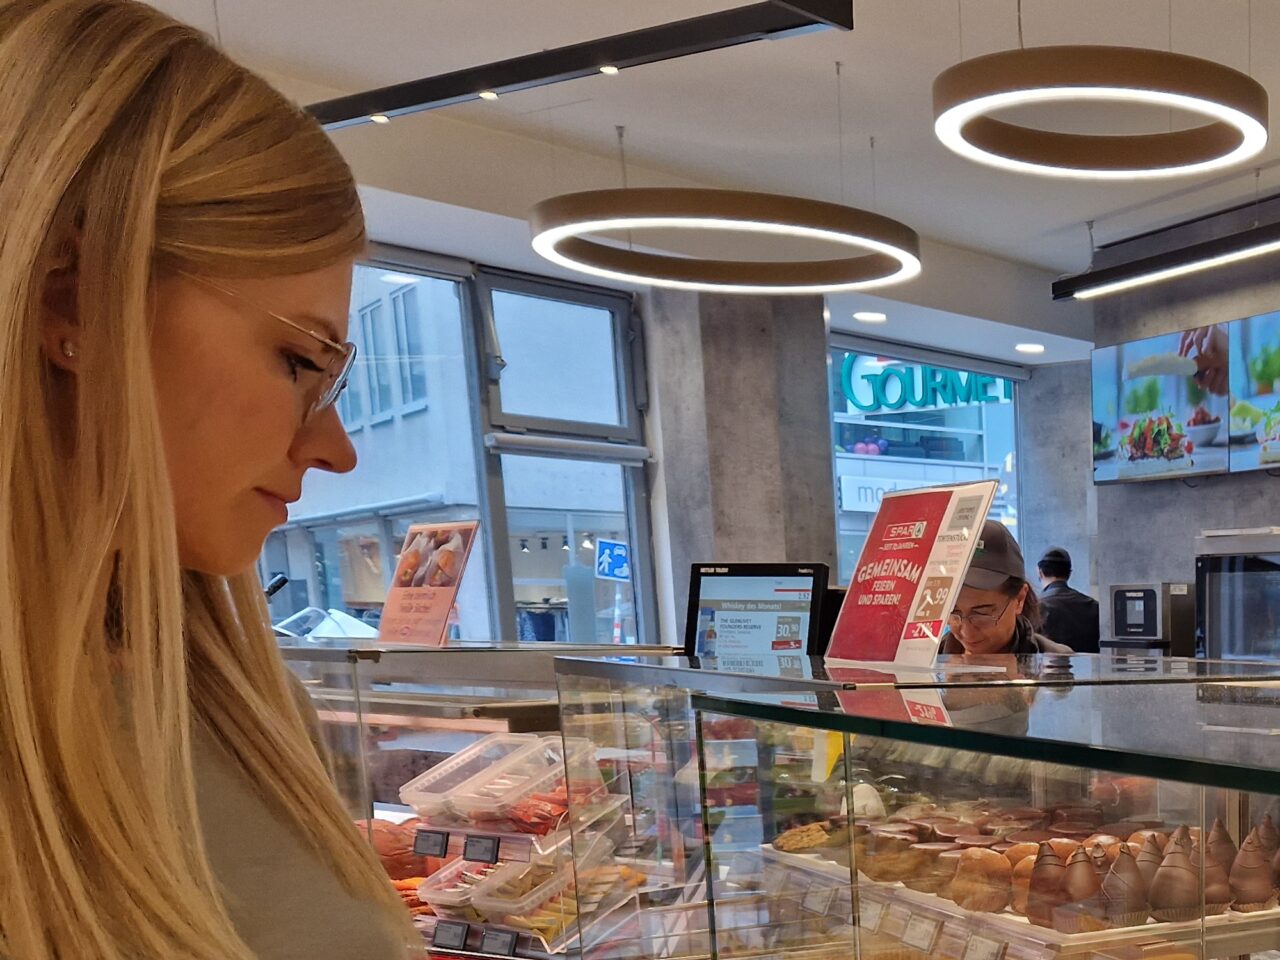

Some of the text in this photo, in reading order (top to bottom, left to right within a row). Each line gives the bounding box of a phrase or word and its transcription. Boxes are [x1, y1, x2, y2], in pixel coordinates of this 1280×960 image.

[889, 525, 915, 537] SPAR
[858, 558, 922, 584] GEMEINSAM
[872, 580, 897, 591] FEIERN
[858, 593, 901, 605] UND SPAREN!
